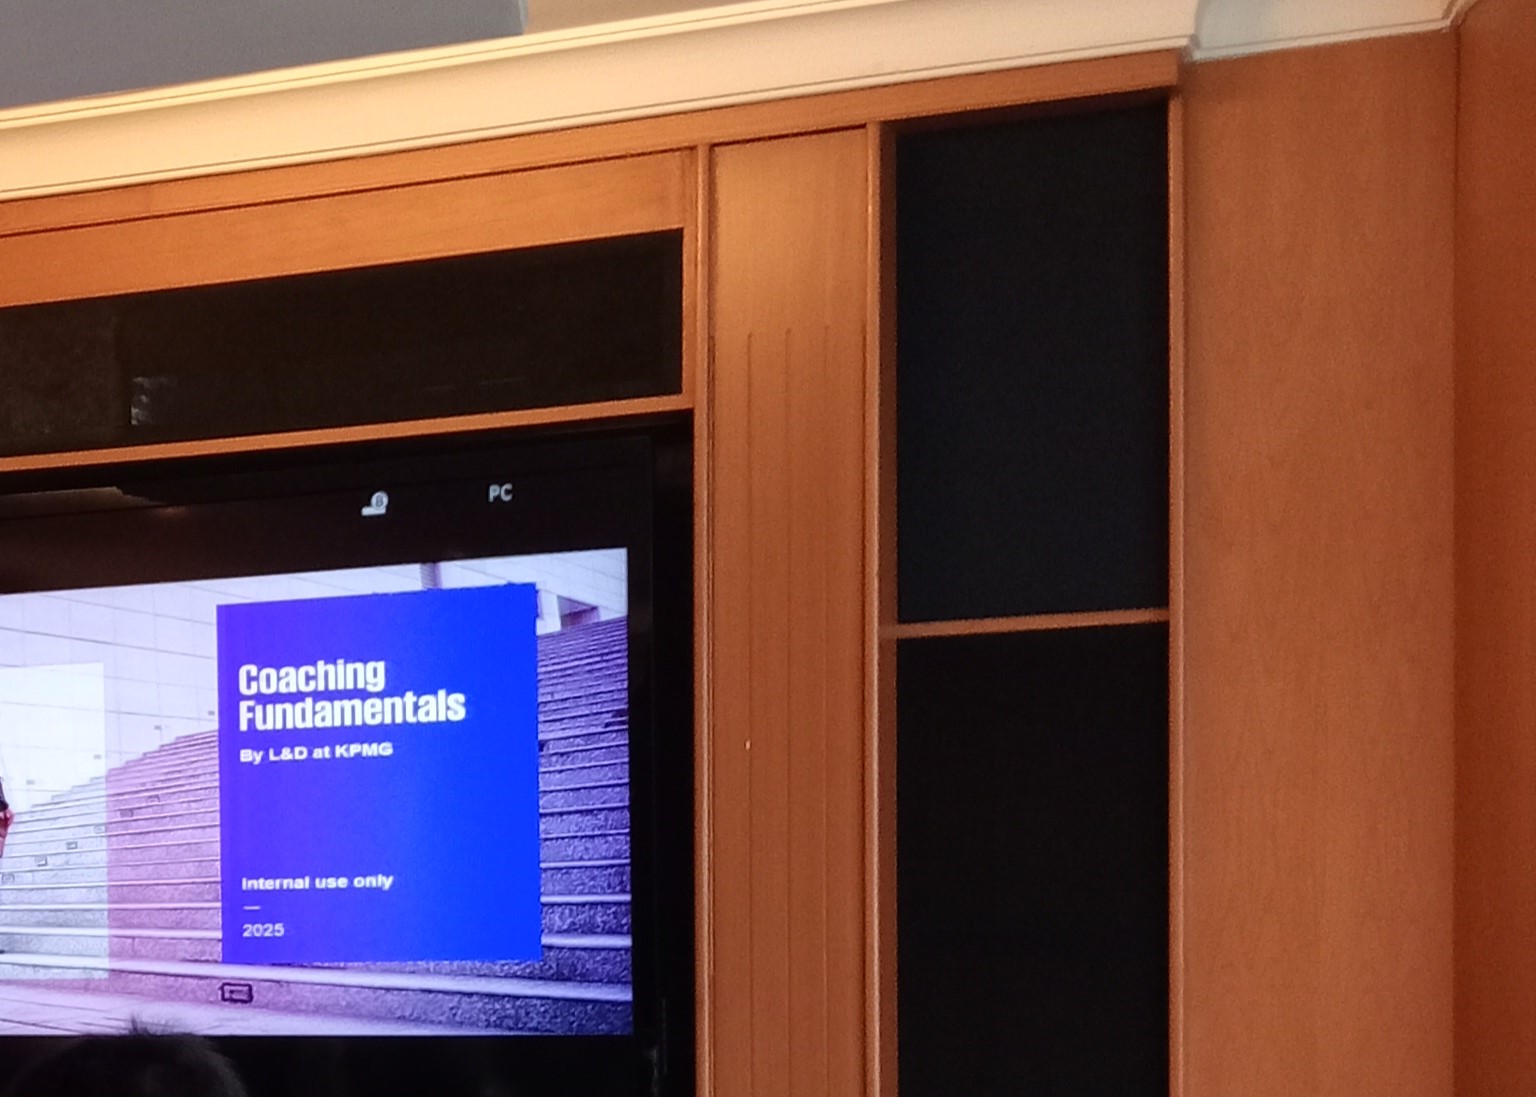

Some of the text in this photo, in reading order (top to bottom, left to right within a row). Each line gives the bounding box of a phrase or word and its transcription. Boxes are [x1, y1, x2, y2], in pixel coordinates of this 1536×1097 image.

[488, 483, 513, 502] PC
[239, 659, 386, 695] Coaching
[239, 689, 466, 731] Fundamentals
[239, 741, 394, 765] By L&D at KPMG
[241, 874, 394, 891] Internal use only
[242, 922, 285, 938] 2025
